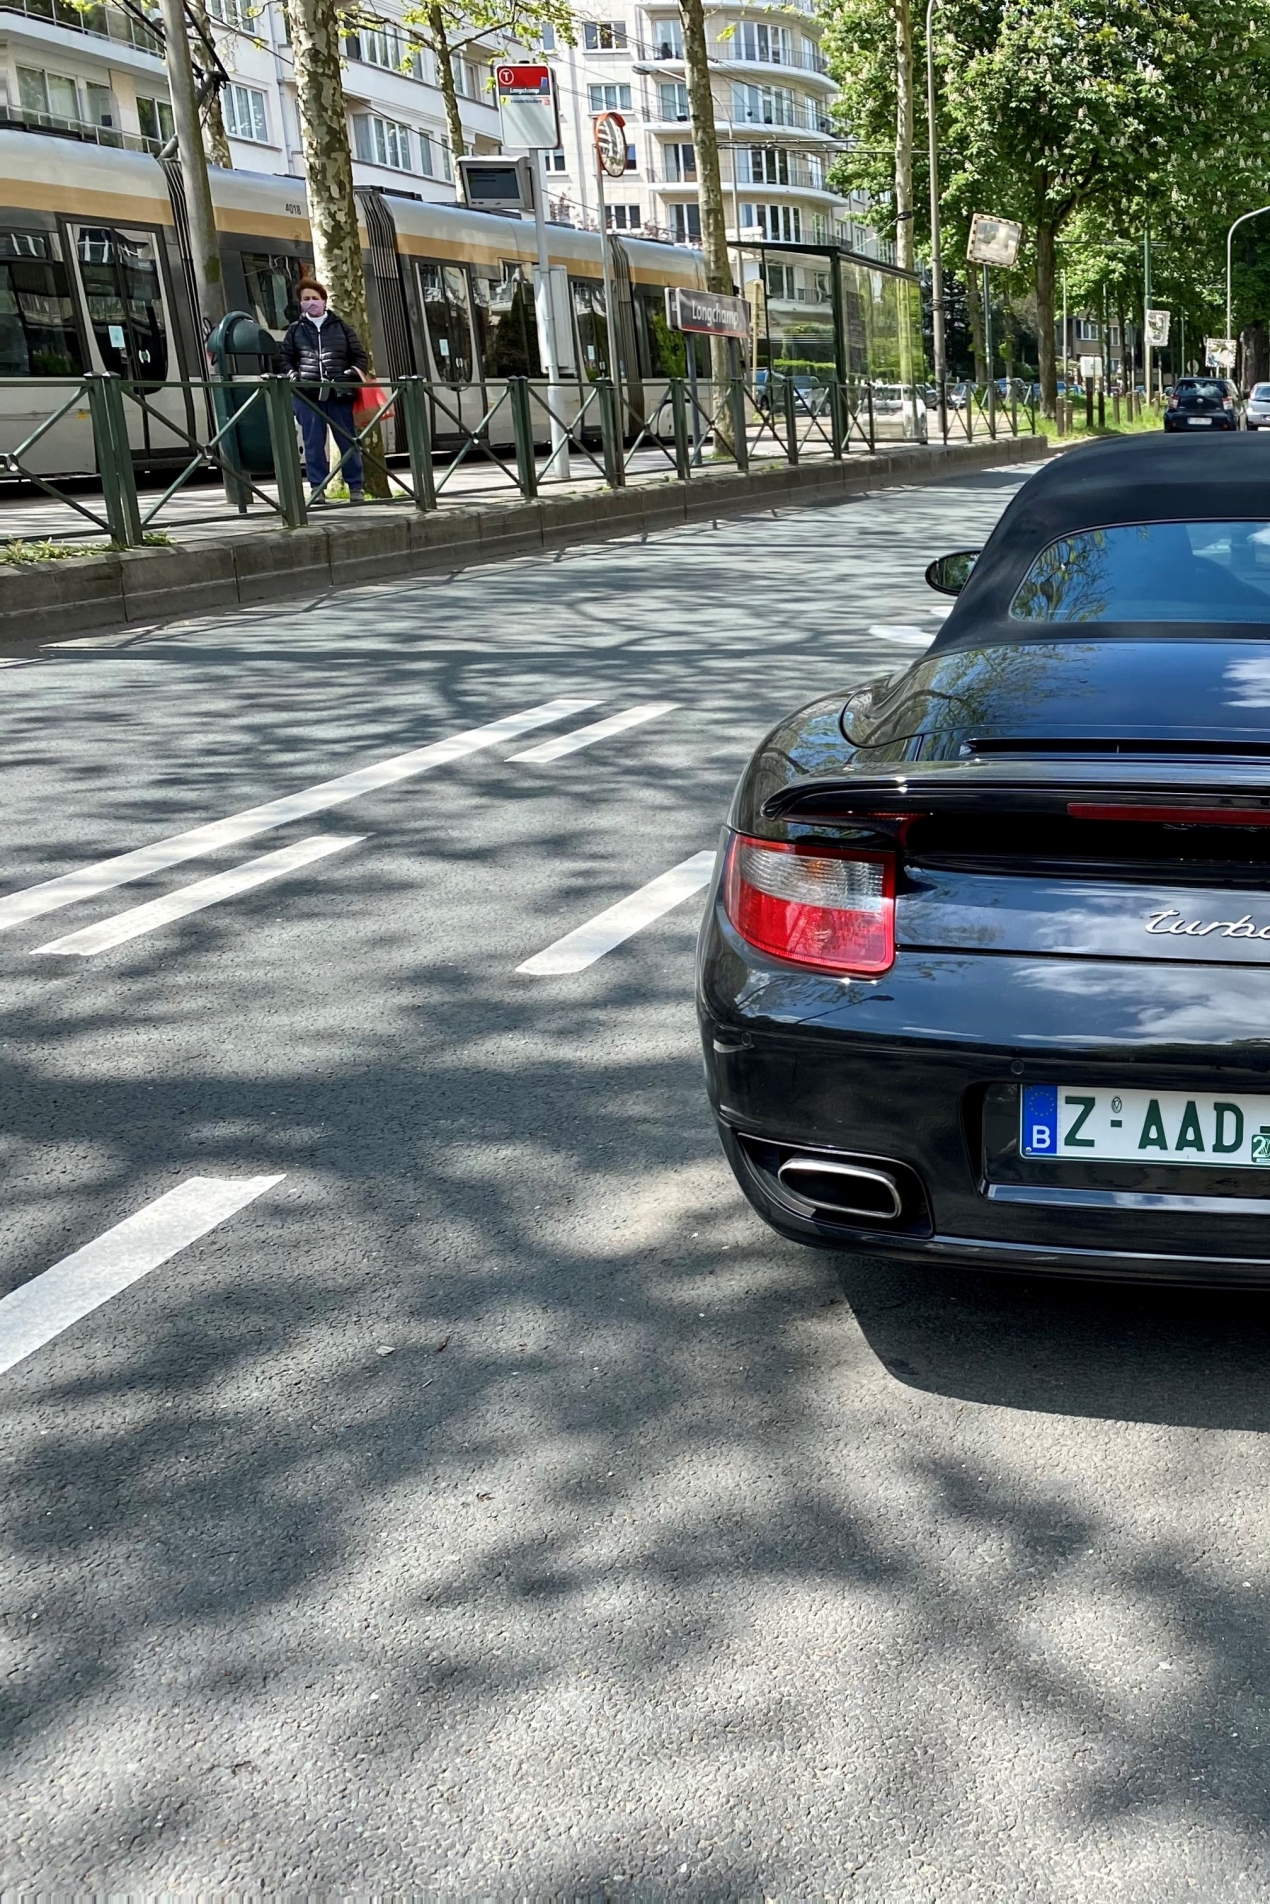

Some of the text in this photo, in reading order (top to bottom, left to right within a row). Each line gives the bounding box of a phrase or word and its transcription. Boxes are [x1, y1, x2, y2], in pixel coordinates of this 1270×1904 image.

[509, 87, 540, 95] Longchamp
[285, 203, 302, 216] 4018
[691, 300, 739, 331] Longchamp
[1032, 1125, 1051, 1149] B
